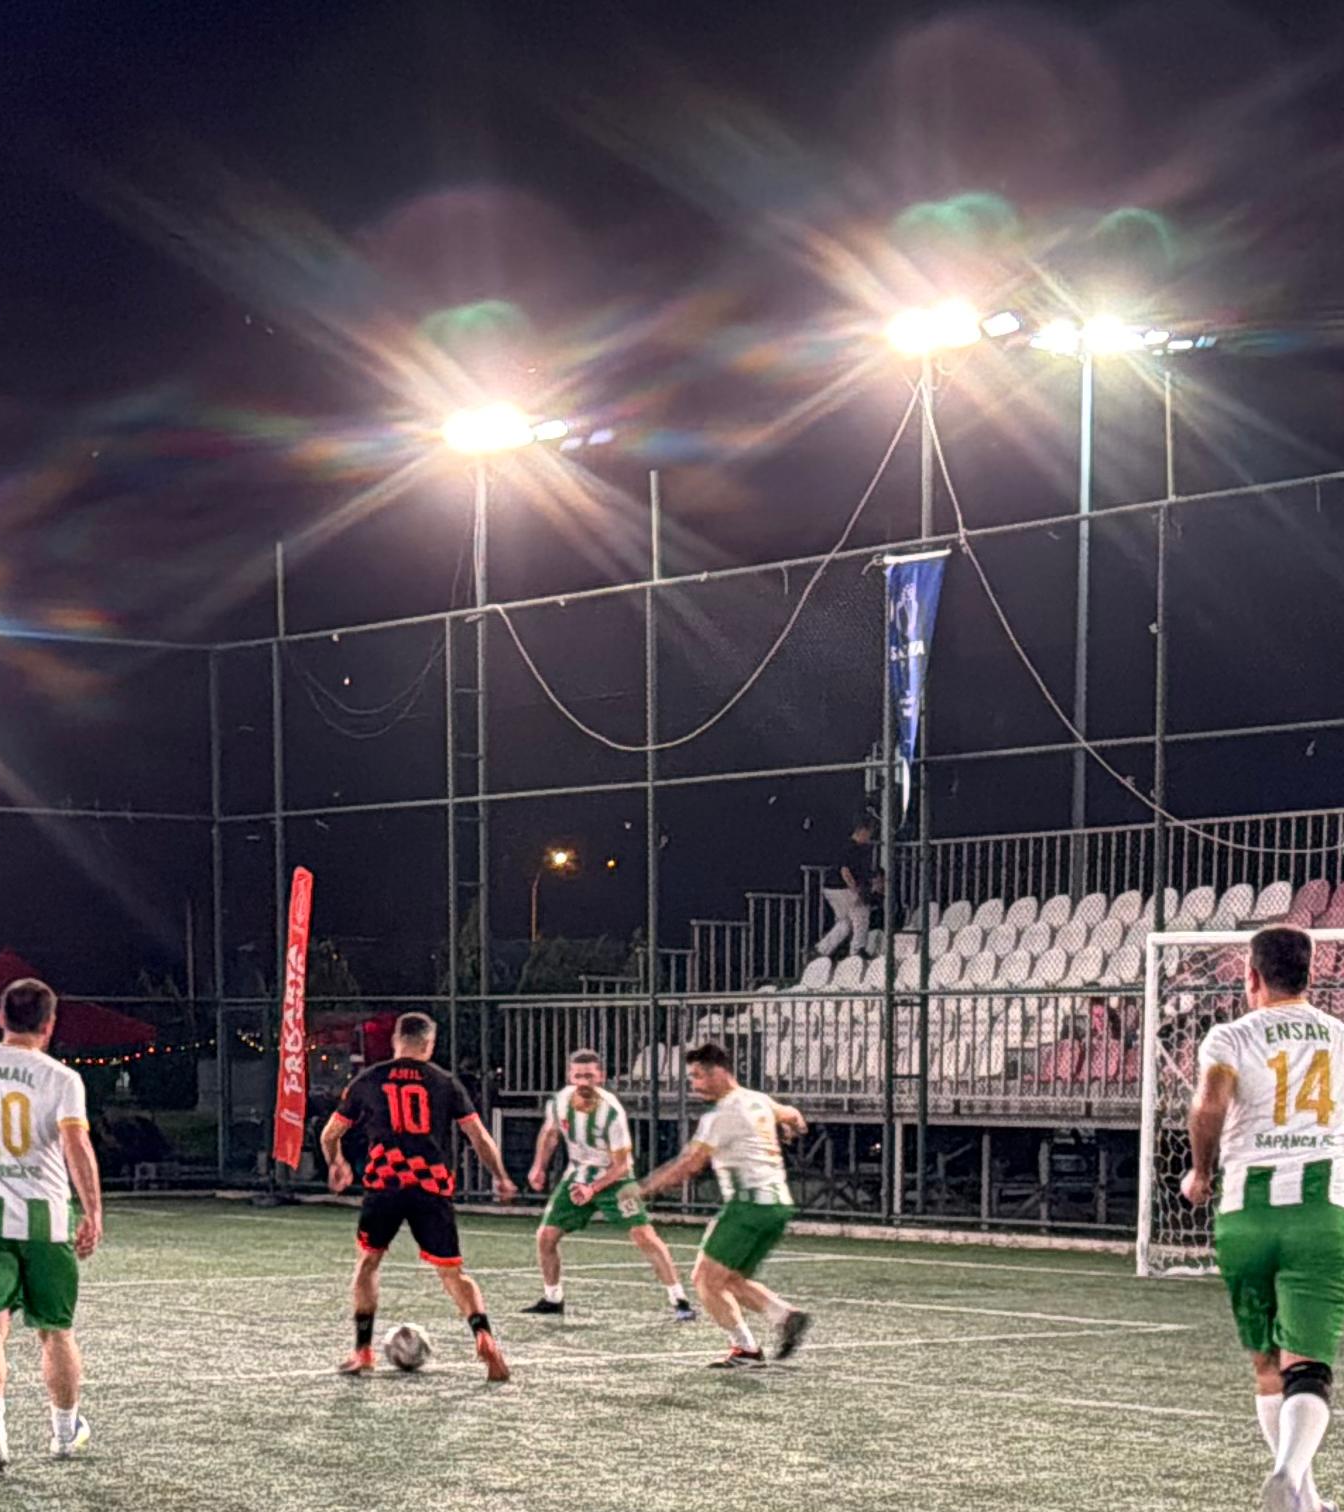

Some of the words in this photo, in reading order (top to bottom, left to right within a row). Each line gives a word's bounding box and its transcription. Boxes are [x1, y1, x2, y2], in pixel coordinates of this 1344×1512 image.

[1264, 1021, 1332, 1043] ENSAR
[381, 1083, 431, 1135] 10
[1267, 1048, 1335, 1128] 14
